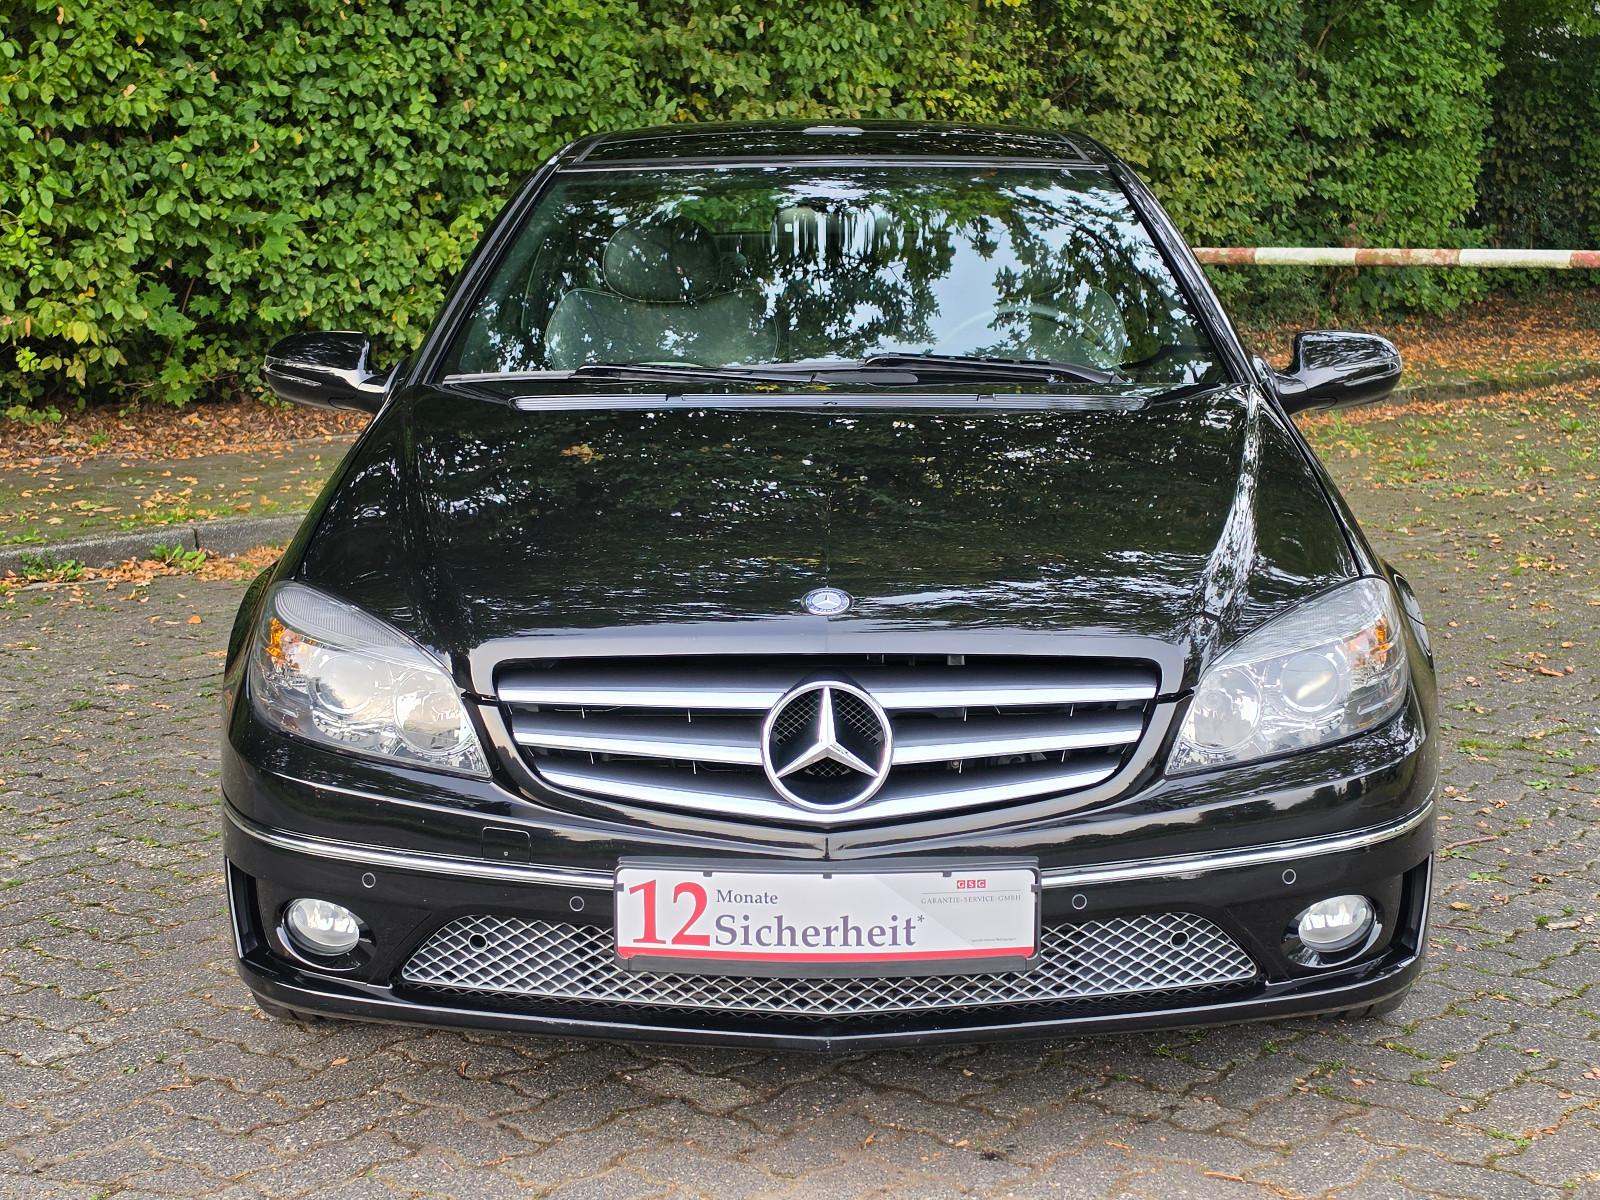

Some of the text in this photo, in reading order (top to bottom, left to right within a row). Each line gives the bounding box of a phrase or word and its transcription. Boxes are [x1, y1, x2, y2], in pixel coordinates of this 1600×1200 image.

[957, 879, 986, 889] GSG
[629, 879, 778, 945] 12 Monate
